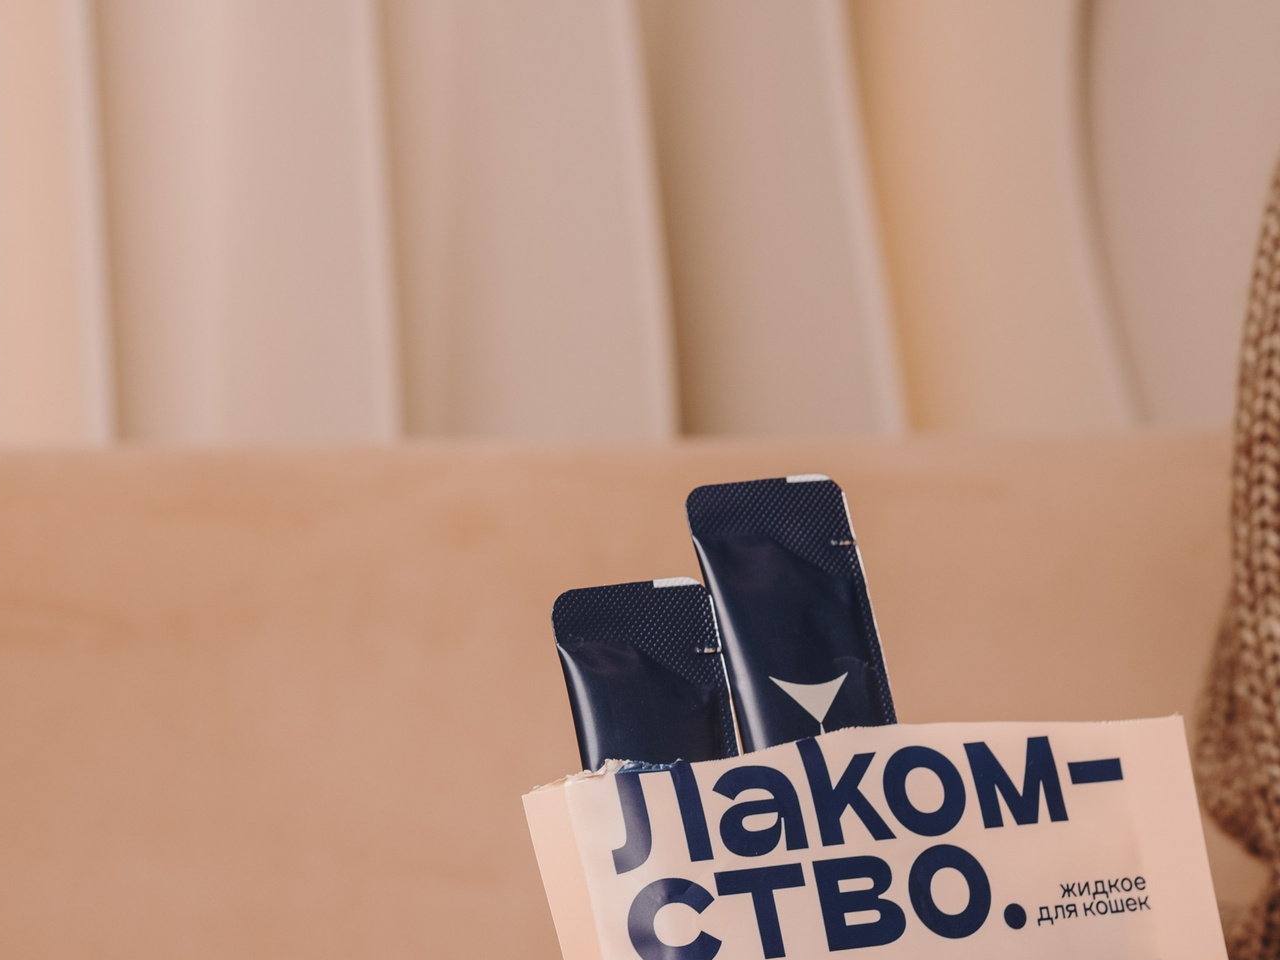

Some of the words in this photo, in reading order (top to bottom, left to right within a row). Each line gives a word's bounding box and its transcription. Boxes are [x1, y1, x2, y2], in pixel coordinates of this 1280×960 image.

[1060, 876, 1146, 899] жидкое
[1037, 903, 1078, 926] для
[1083, 896, 1151, 916] кошек
